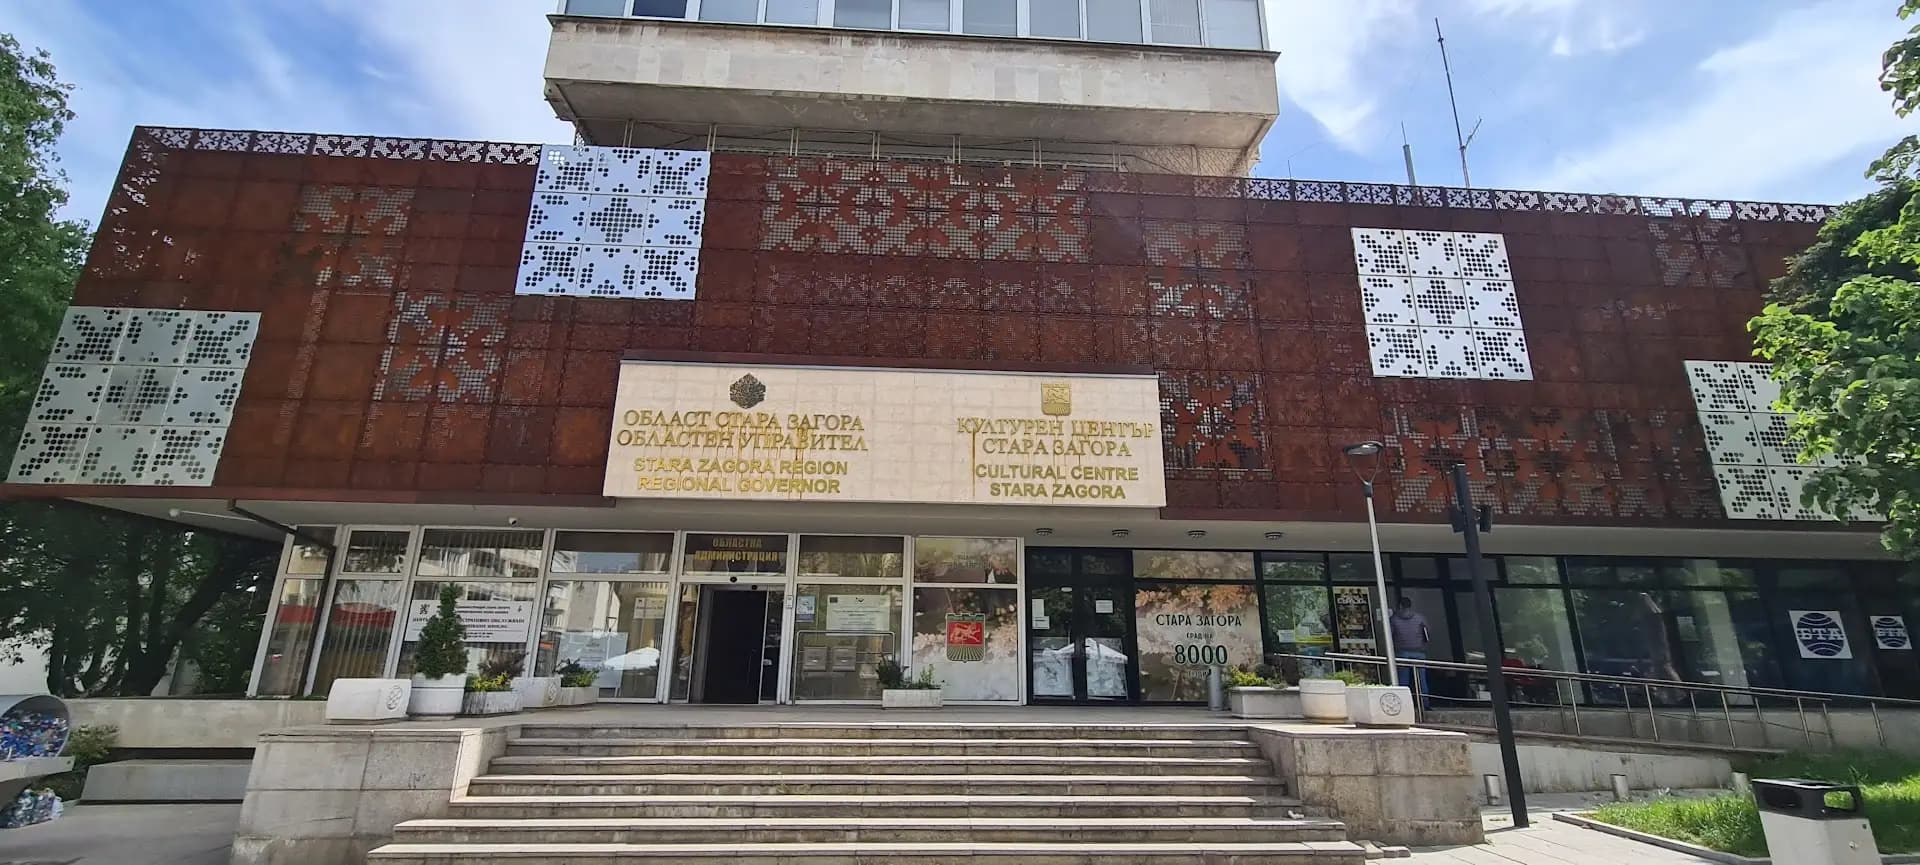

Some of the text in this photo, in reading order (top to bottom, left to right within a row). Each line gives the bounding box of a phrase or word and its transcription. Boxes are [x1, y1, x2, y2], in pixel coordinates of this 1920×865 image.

[624, 409, 865, 431] ОБЛАСТ СТАРА ЗАГОРА
[957, 417, 1154, 438] КУЛТУРЕН ЦЕНТЪР
[616, 429, 869, 451] ОБЛАСТЕН УПРАВИТЕЛ
[982, 438, 1132, 456] СТАРА ЗАГОРА
[633, 457, 848, 475] STARA ZAGORA REGION
[975, 464, 1139, 481] CULTURAL CENTRE
[637, 476, 840, 493] REGIONAL GOVERNOR
[990, 482, 1126, 499] STARA ZAGORA
[712, 537, 762, 548] ОБЛАСТНА
[695, 550, 778, 561] АДМИНИСТРАЦИЯ
[1156, 614, 1242, 626] СТАРА ЗАГОРА
[1797, 628, 1844, 640] БТА
[1874, 628, 1908, 637] БТА
[1174, 644, 1228, 665] 8000
